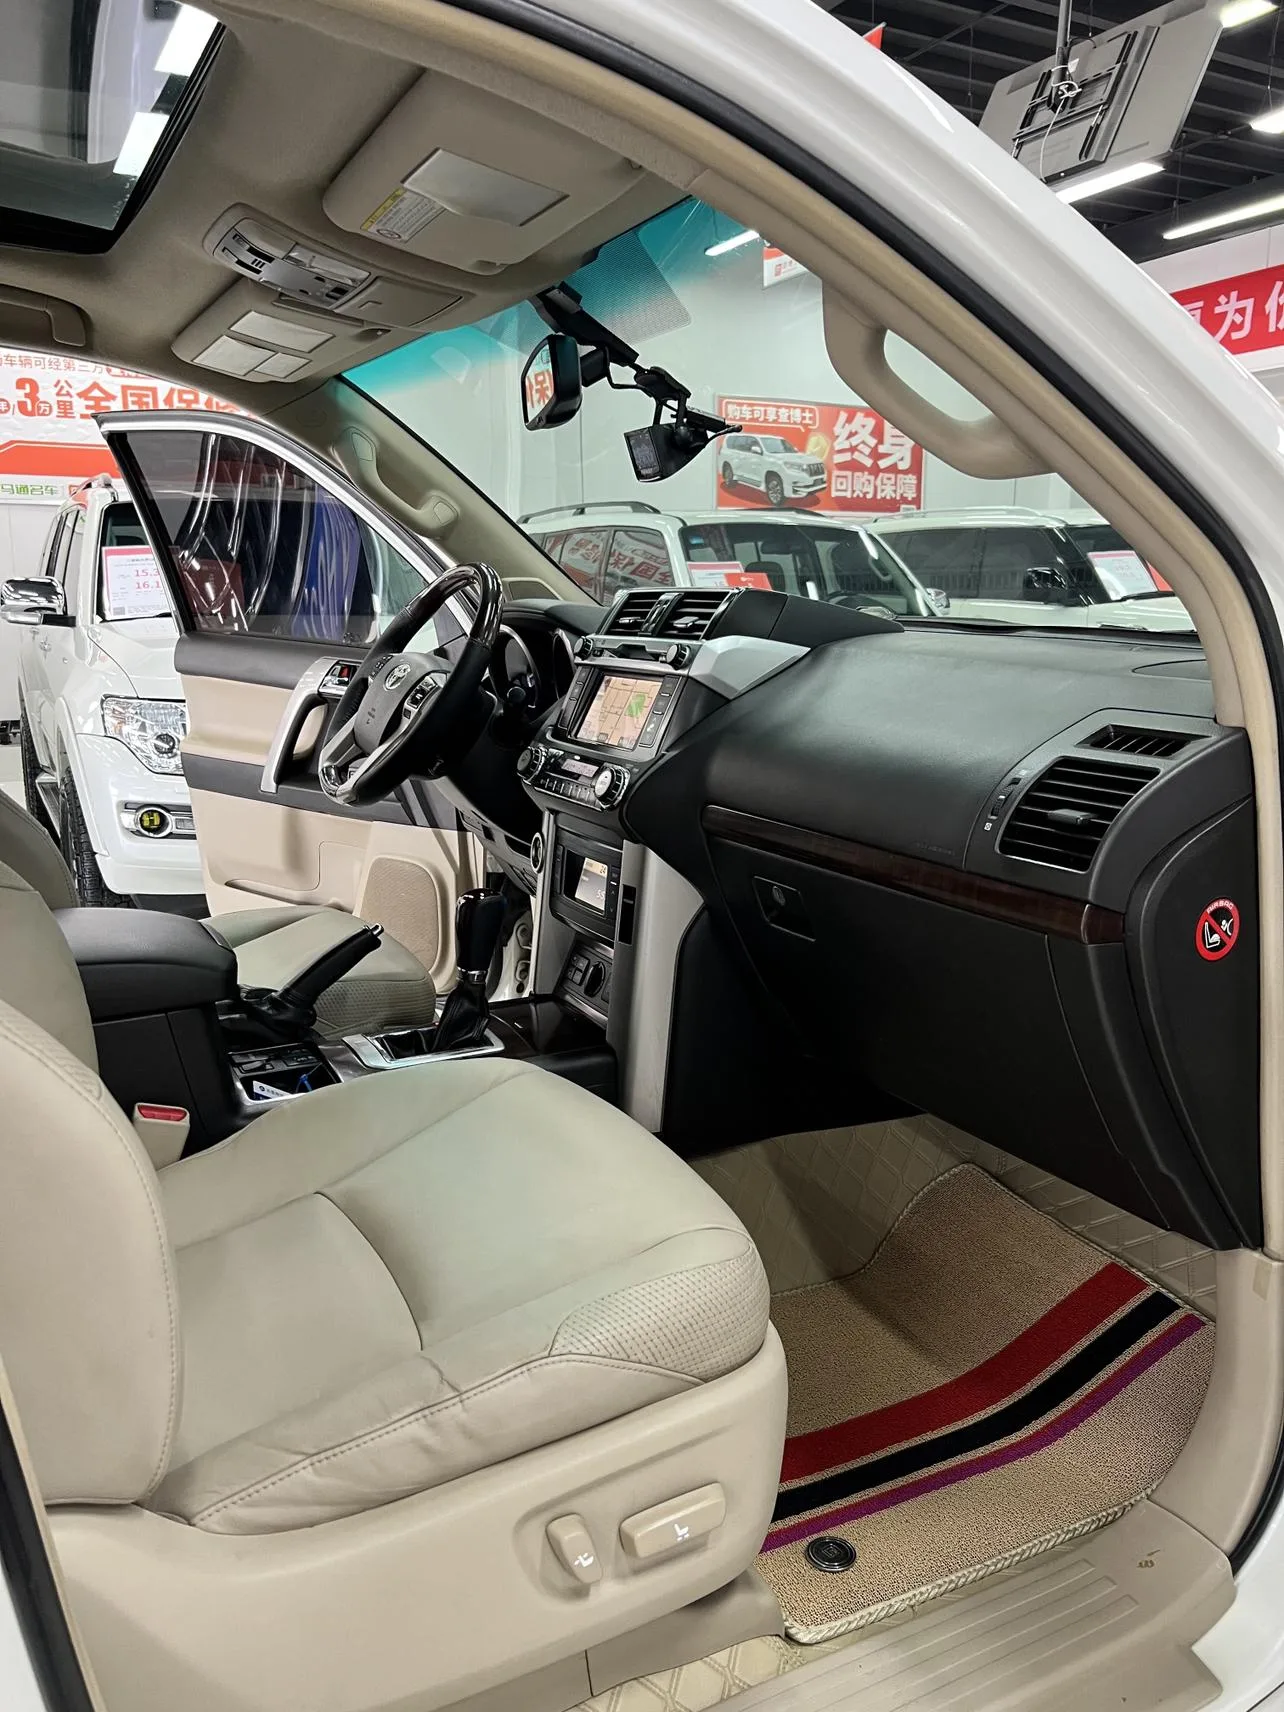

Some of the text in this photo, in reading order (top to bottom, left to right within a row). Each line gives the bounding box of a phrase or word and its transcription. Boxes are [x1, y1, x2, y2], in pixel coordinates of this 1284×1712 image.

[0, 353, 104, 375] 车辆可经第三方
[727, 403, 814, 425] 购车可享查博士
[832, 411, 917, 471] 终身
[831, 470, 918, 501] 回购保障
